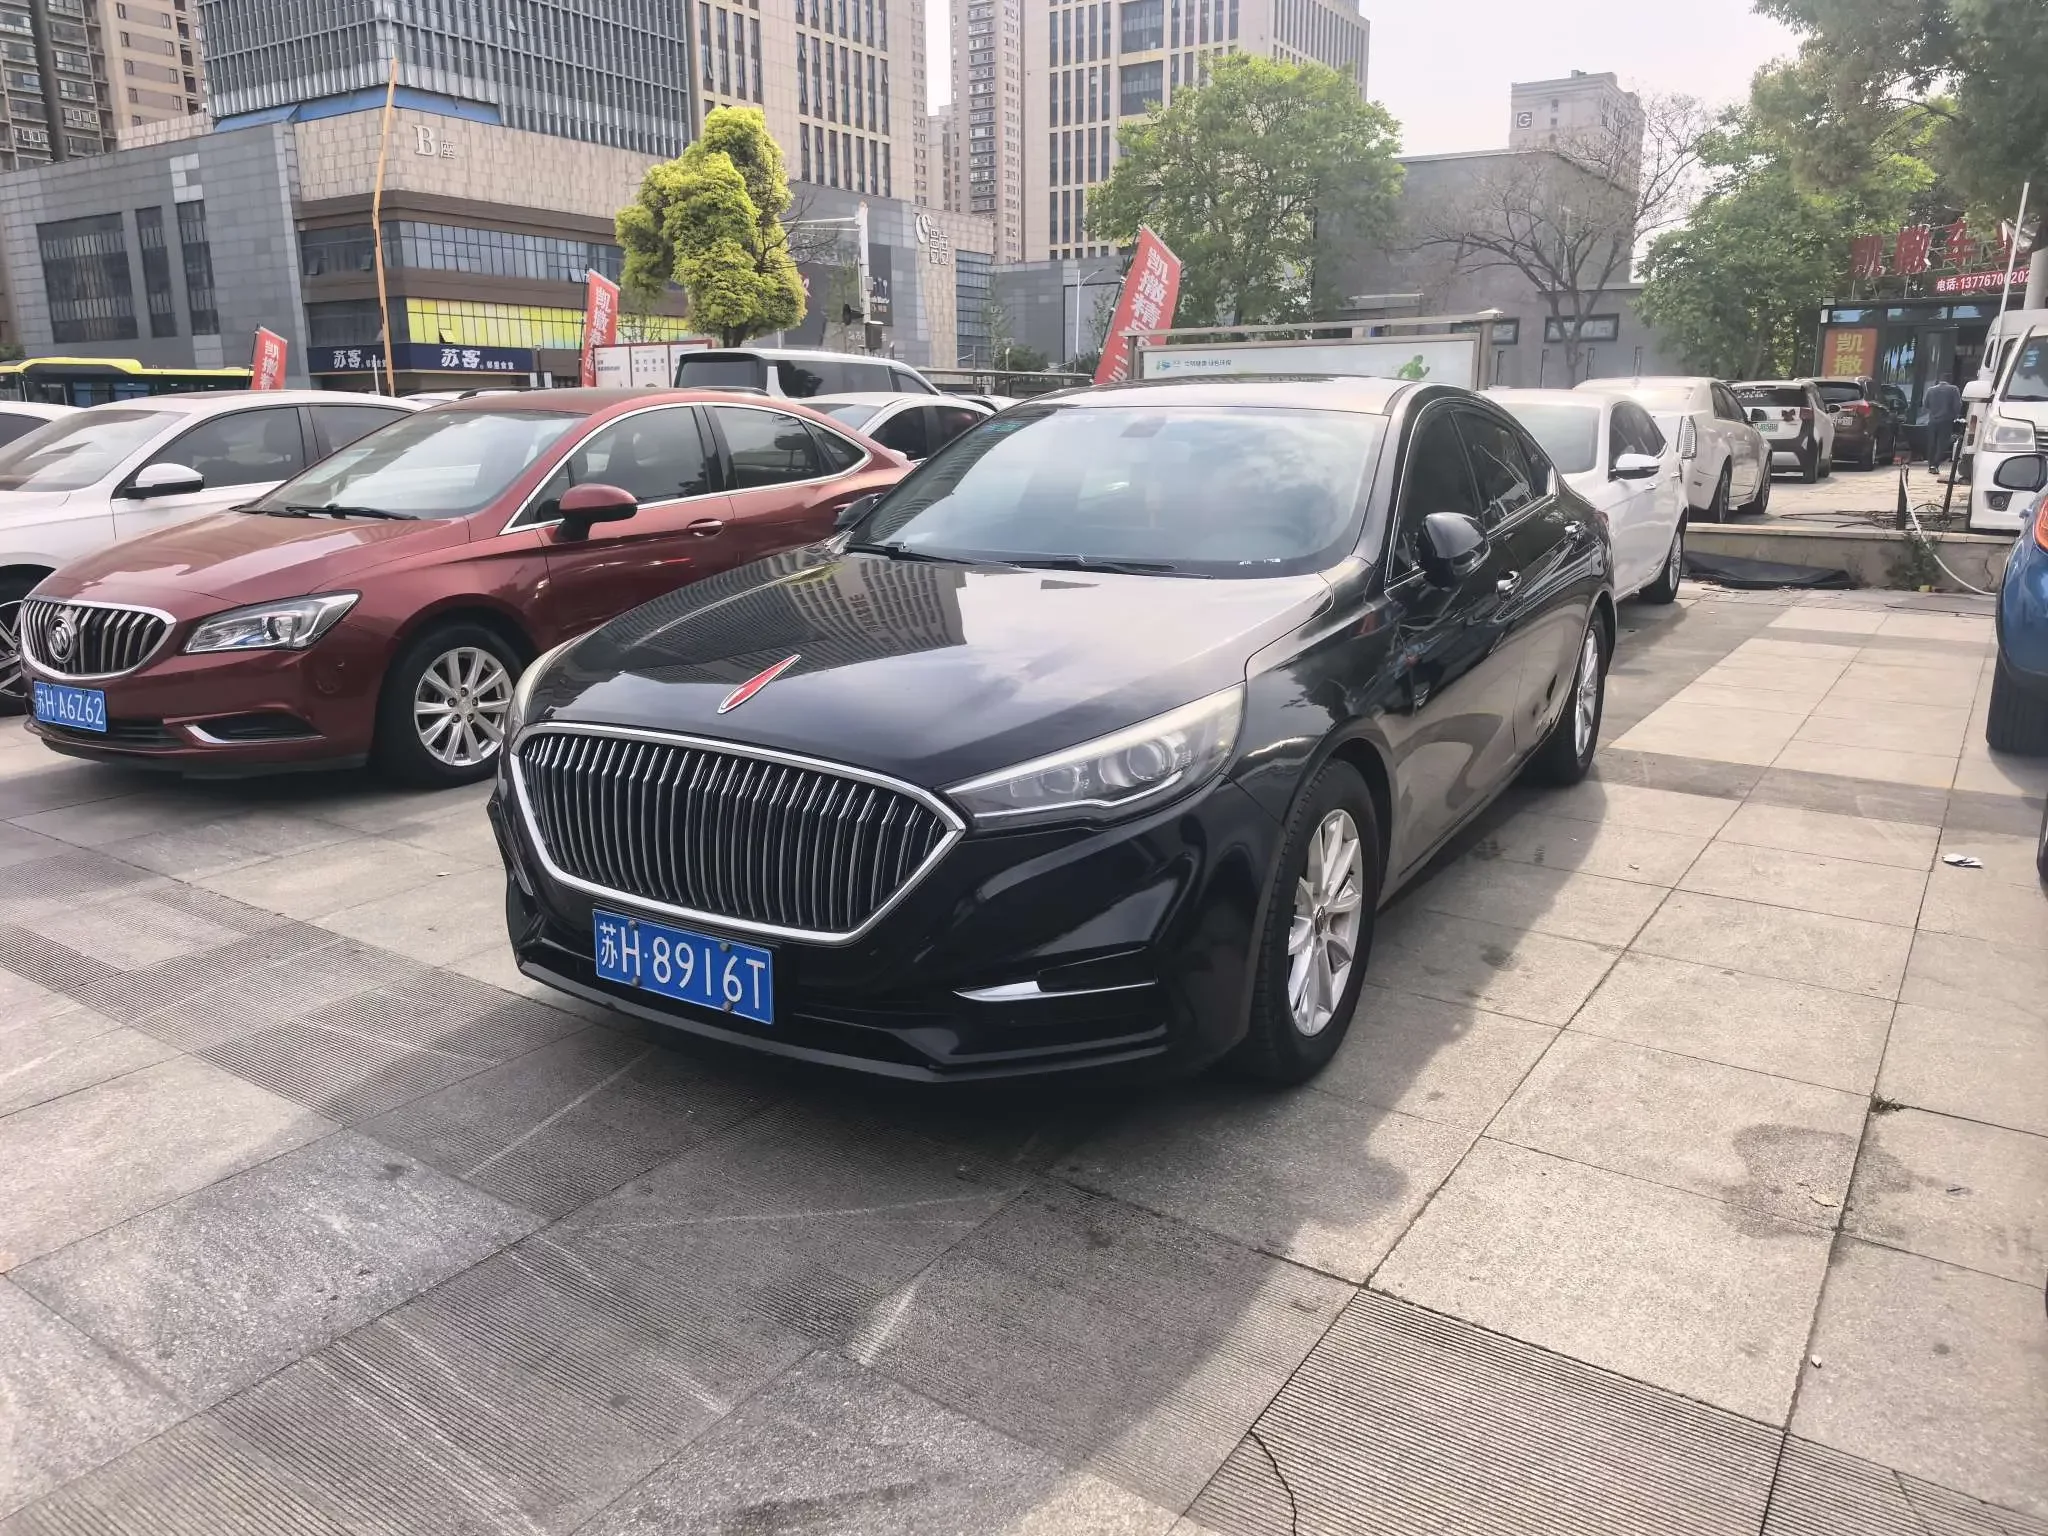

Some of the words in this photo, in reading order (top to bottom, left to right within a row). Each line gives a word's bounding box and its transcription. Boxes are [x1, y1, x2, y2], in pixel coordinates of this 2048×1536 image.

[1936, 269, 2030, 291] 电话:1377670202
[1109, 247, 1169, 381] 凯撒精品
[333, 349, 361, 369] 苏客
[441, 348, 480, 368] 苏客
[1834, 333, 1863, 375] 凯撒
[600, 921, 766, 1010] 苏H·8916T
